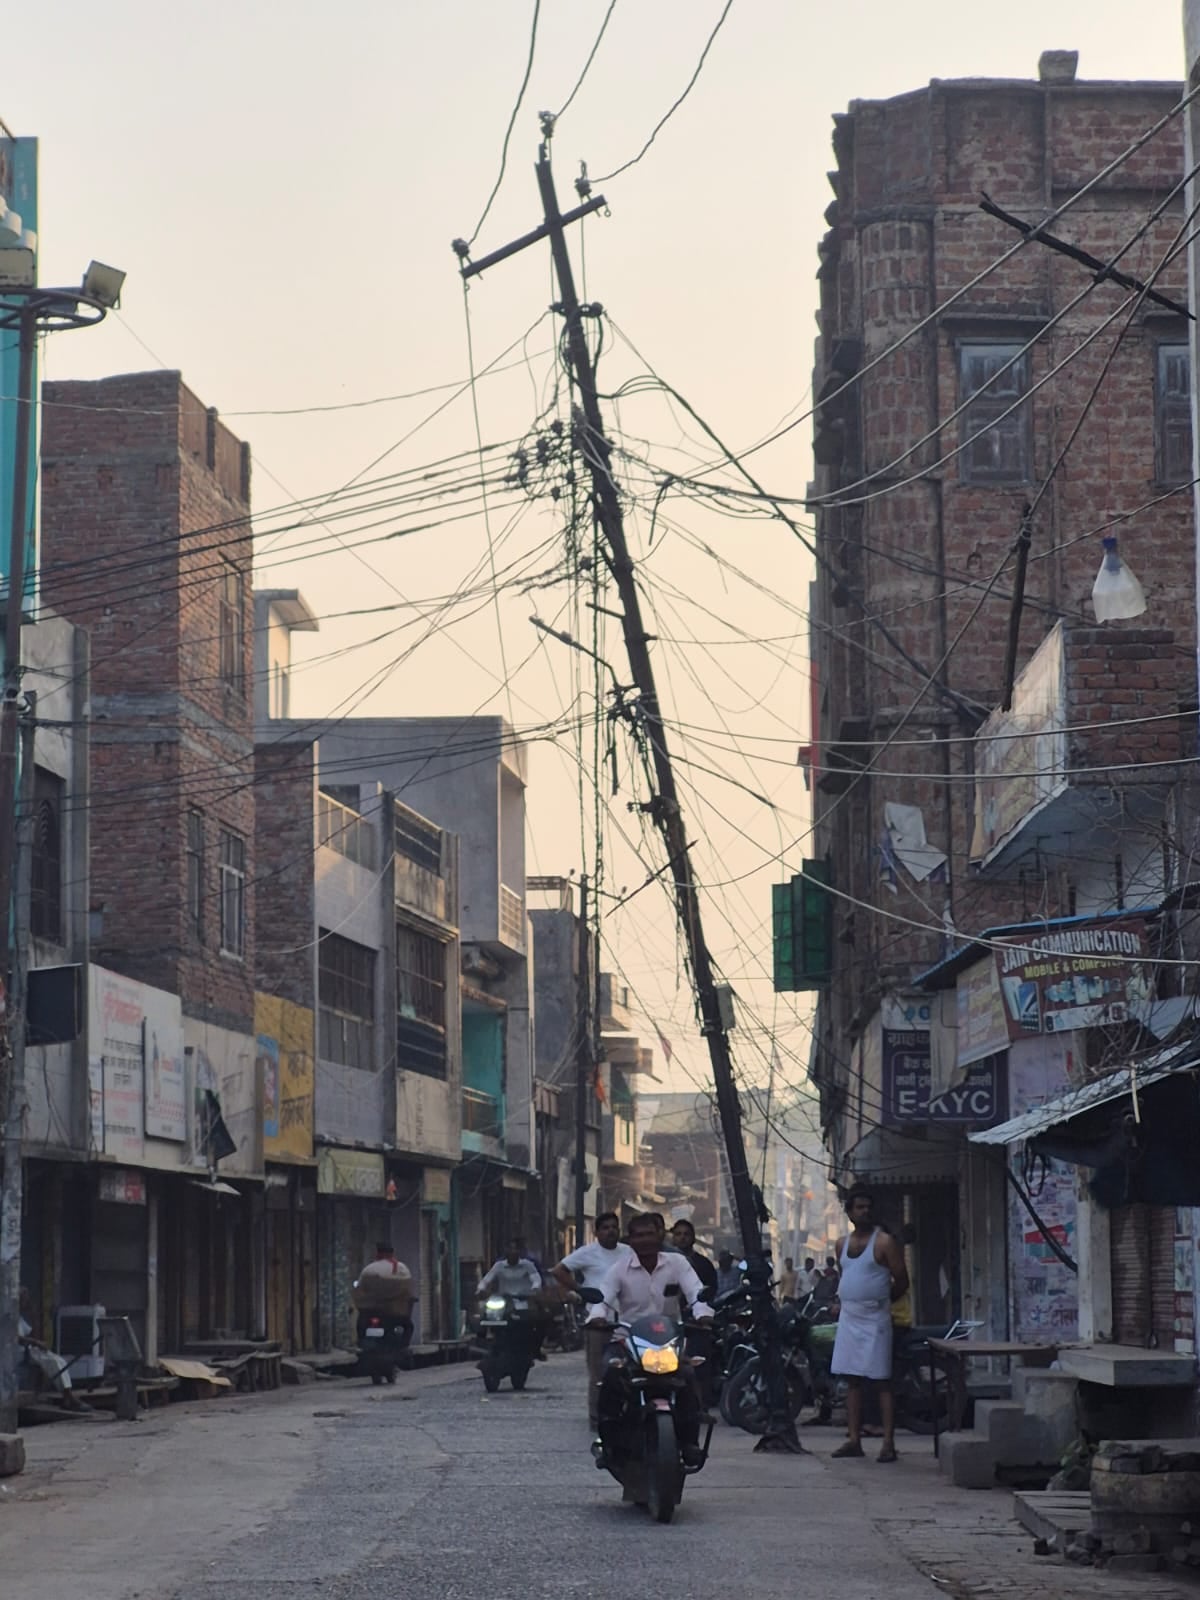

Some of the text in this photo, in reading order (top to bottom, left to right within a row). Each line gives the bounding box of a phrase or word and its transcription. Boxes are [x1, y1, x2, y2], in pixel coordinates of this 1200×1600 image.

[1001, 942, 1030, 973] JAIN
[1024, 961, 1060, 979] MOBILE
[1062, 961, 1070, 973] &
[898, 1090, 990, 1114] E-KYC
